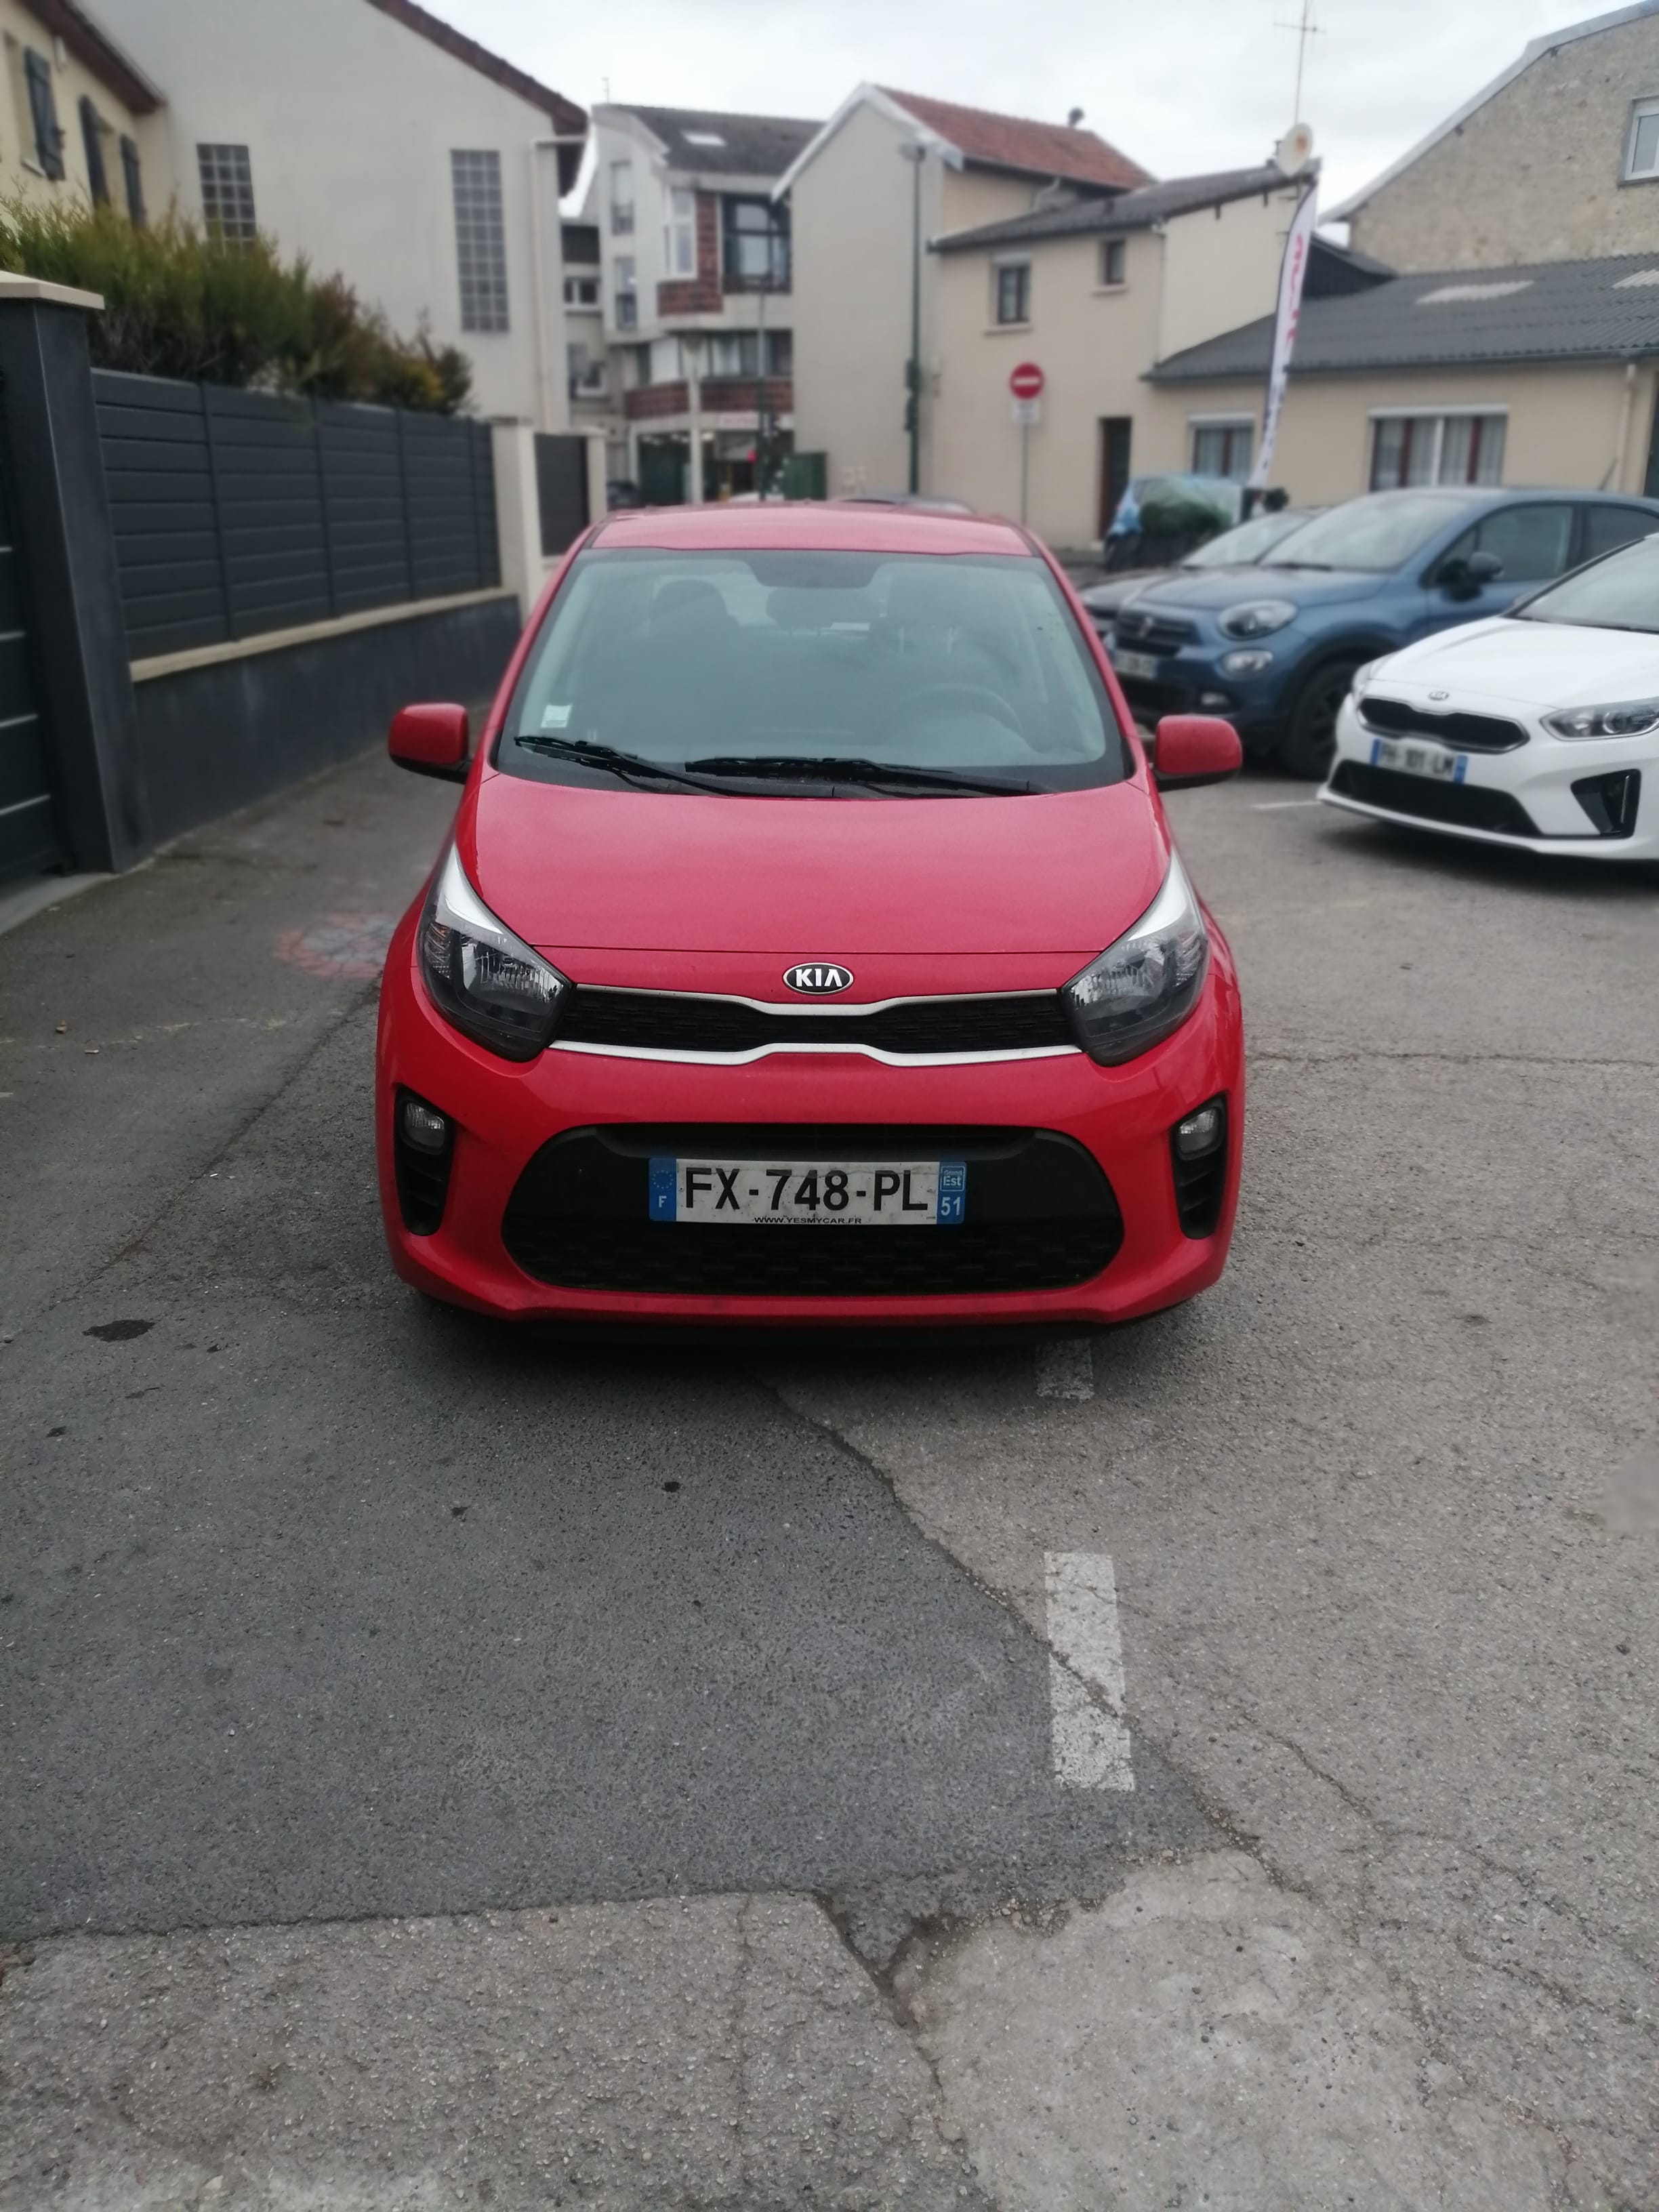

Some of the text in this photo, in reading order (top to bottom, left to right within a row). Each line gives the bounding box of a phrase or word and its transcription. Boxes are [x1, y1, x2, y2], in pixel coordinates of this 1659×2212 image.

[795, 968, 842, 987] KIA
[685, 1167, 928, 1211] FX-748-PL
[943, 1176, 962, 1186] Est
[659, 1195, 667, 1208] F
[941, 1197, 961, 1216] 51
